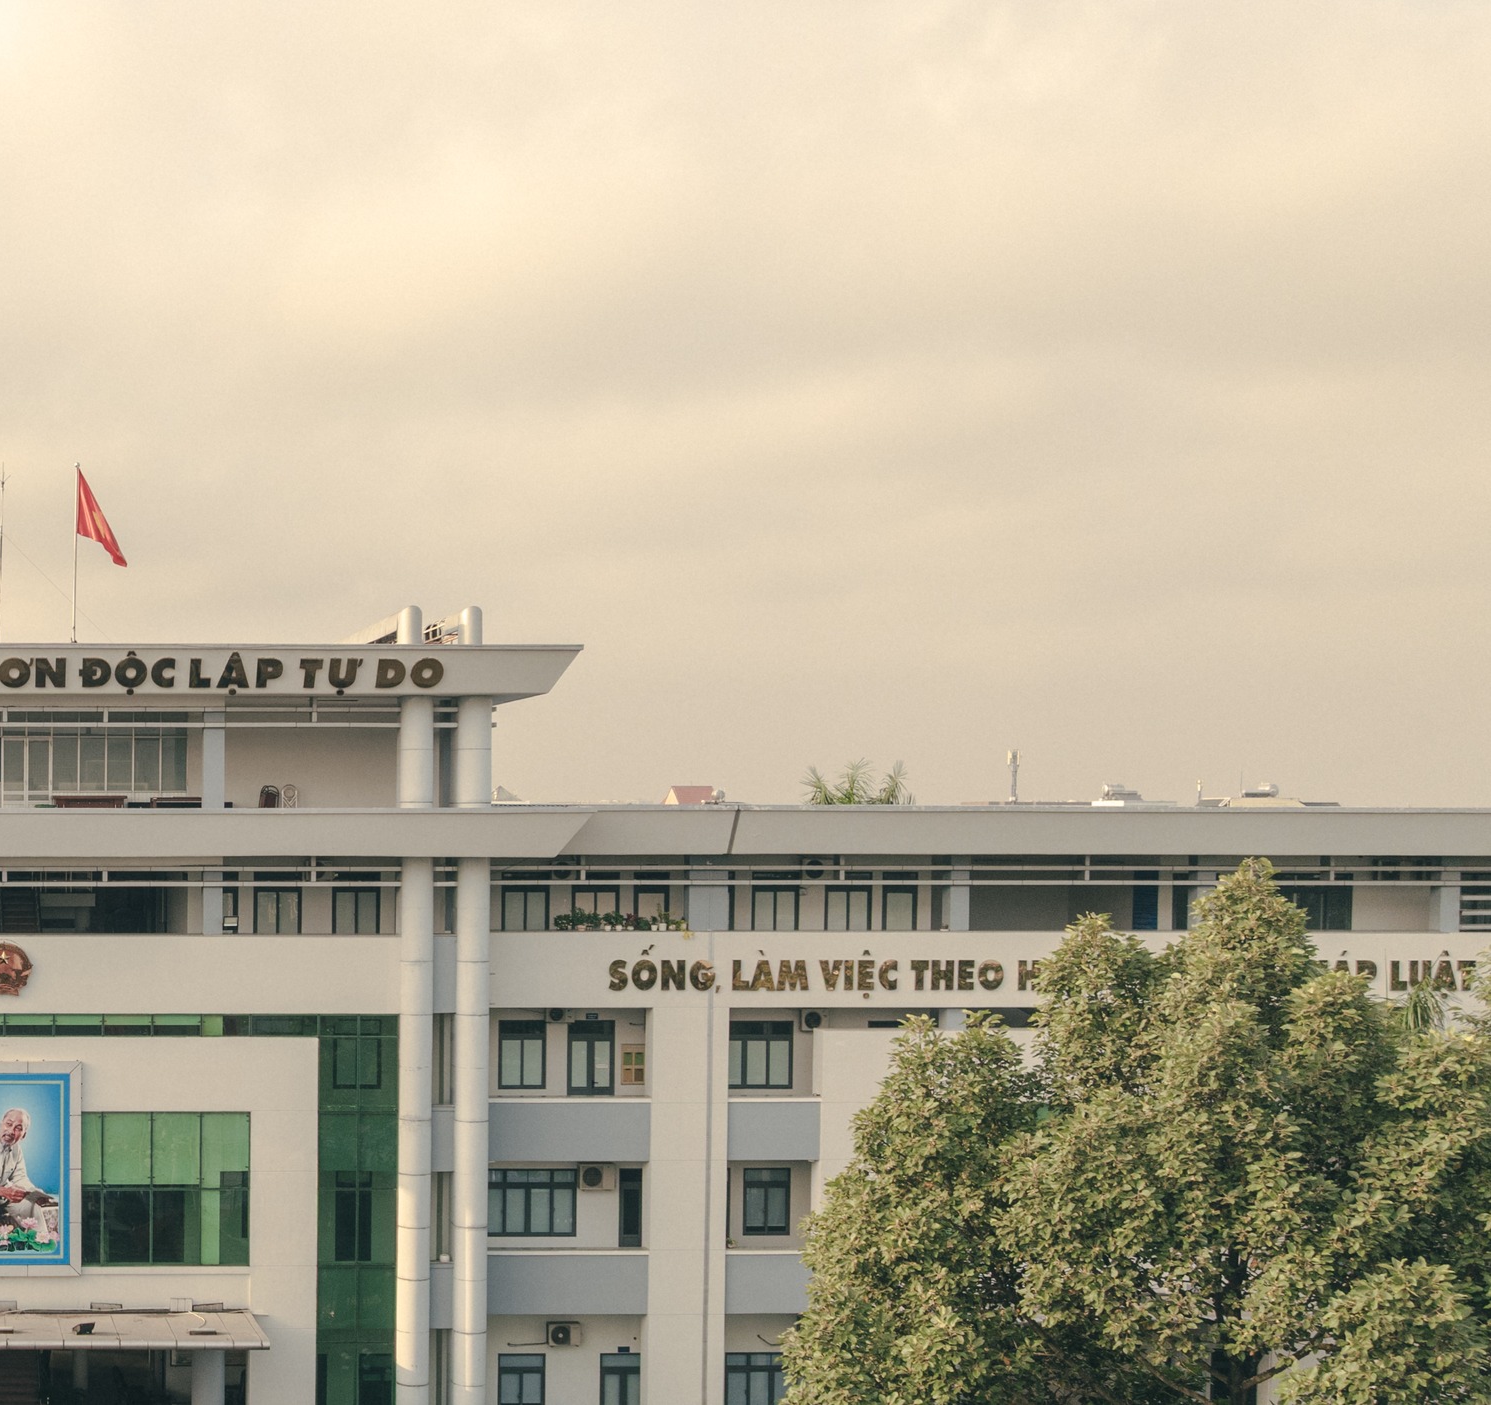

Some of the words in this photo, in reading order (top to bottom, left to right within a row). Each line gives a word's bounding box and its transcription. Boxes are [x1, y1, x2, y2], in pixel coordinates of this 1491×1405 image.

[79, 651, 176, 695] ĐỘC
[189, 652, 284, 695] LẬP
[300, 657, 363, 695] TỰ
[375, 657, 444, 688] DO
[609, 945, 721, 993] SỐNG,
[732, 950, 809, 991] LÀM
[819, 950, 898, 1000] VIỆC
[911, 960, 1004, 991] THEO
